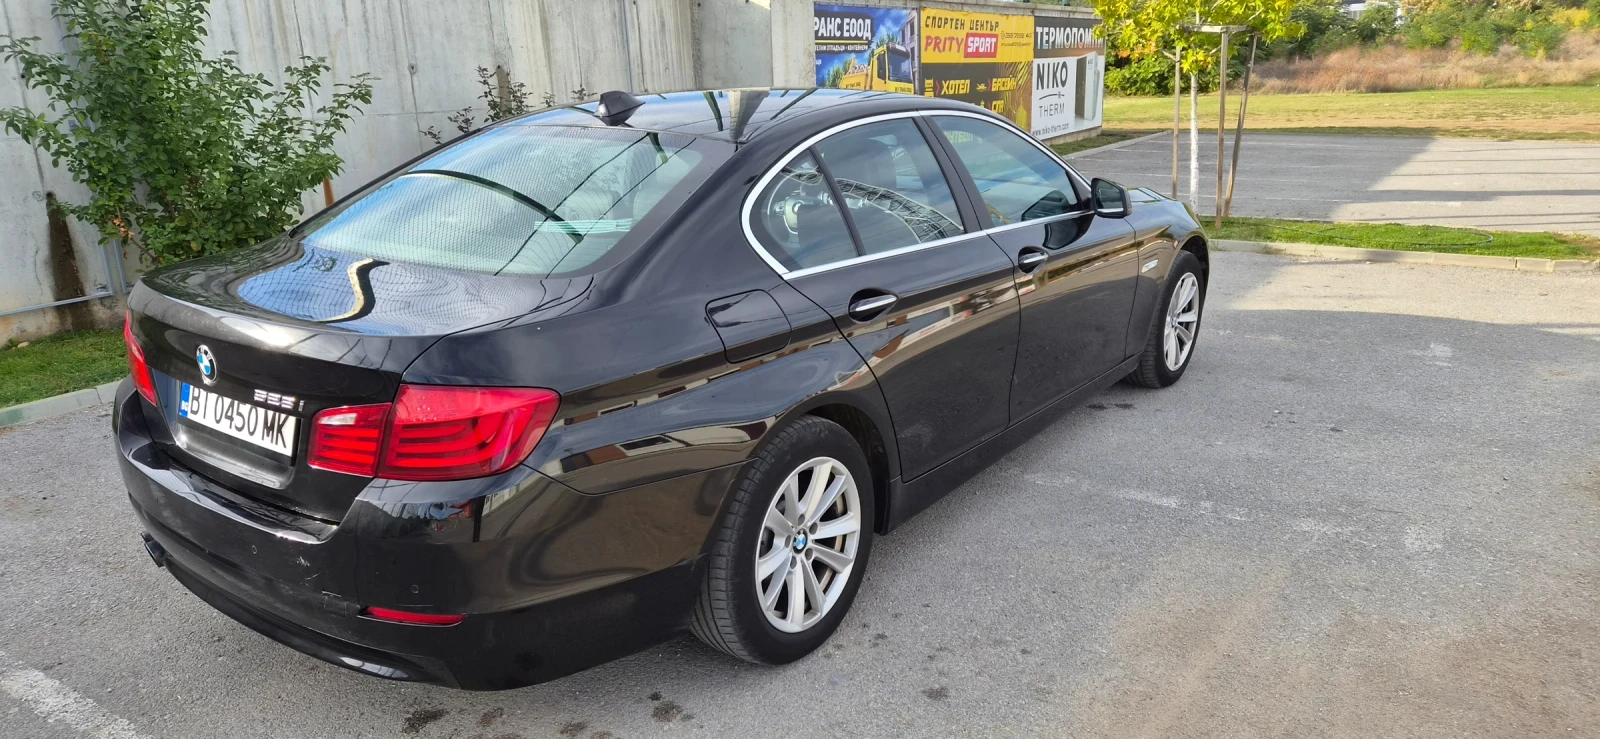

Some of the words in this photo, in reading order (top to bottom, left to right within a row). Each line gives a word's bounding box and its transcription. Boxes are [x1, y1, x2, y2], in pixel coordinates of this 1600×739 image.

[843, 18, 872, 41] ЕООД
[925, 15, 966, 31] СПОРТЕН
[969, 19, 1000, 33] ЦЕНТЪР
[924, 35, 964, 54] PRITY
[967, 36, 997, 53] SPORT
[941, 79, 971, 96] ХОТЕЛ
[992, 75, 1017, 92] БАСЕЙН
[1036, 60, 1068, 91] NIKO
[991, 99, 1005, 114] СПА
[1038, 102, 1066, 118] THERM
[214, 395, 259, 437] 0450
[261, 409, 290, 449] MK
